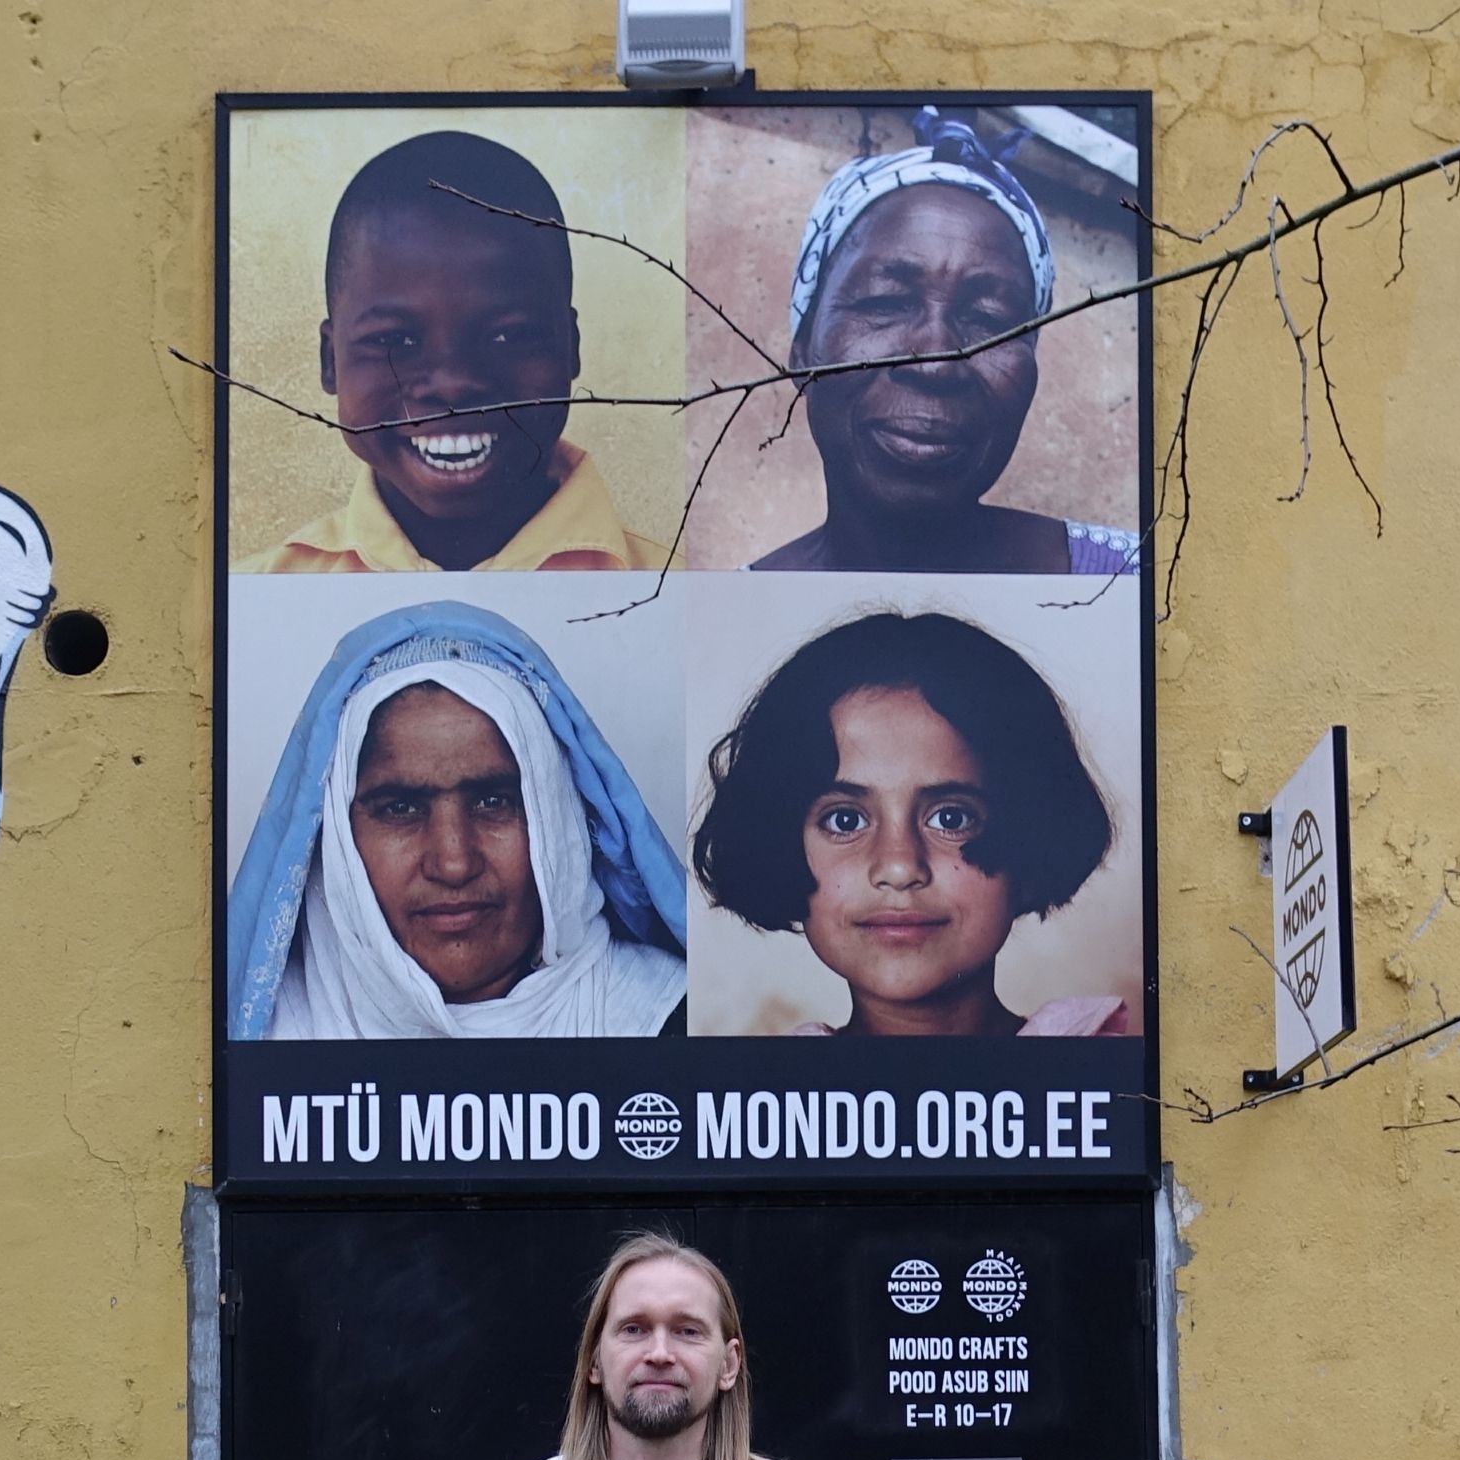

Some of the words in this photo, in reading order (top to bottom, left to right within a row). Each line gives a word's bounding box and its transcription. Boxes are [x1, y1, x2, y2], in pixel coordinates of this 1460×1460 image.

[1282, 873, 1327, 948] MONDO
[263, 1083, 380, 1162] MTÜ
[401, 1092, 601, 1161] MONDO
[614, 1118, 683, 1134] MONDO
[696, 1090, 1111, 1160] MONDO.ORG.EE
[887, 1280, 942, 1293] MONDO
[962, 1280, 1017, 1292] MONDO
[889, 1337, 953, 1361] MONDO
[958, 1336, 1028, 1360] CRAFTS
[889, 1370, 936, 1394] POOD
[941, 1370, 989, 1393] ASUB
[994, 1370, 1029, 1393] SIIN
